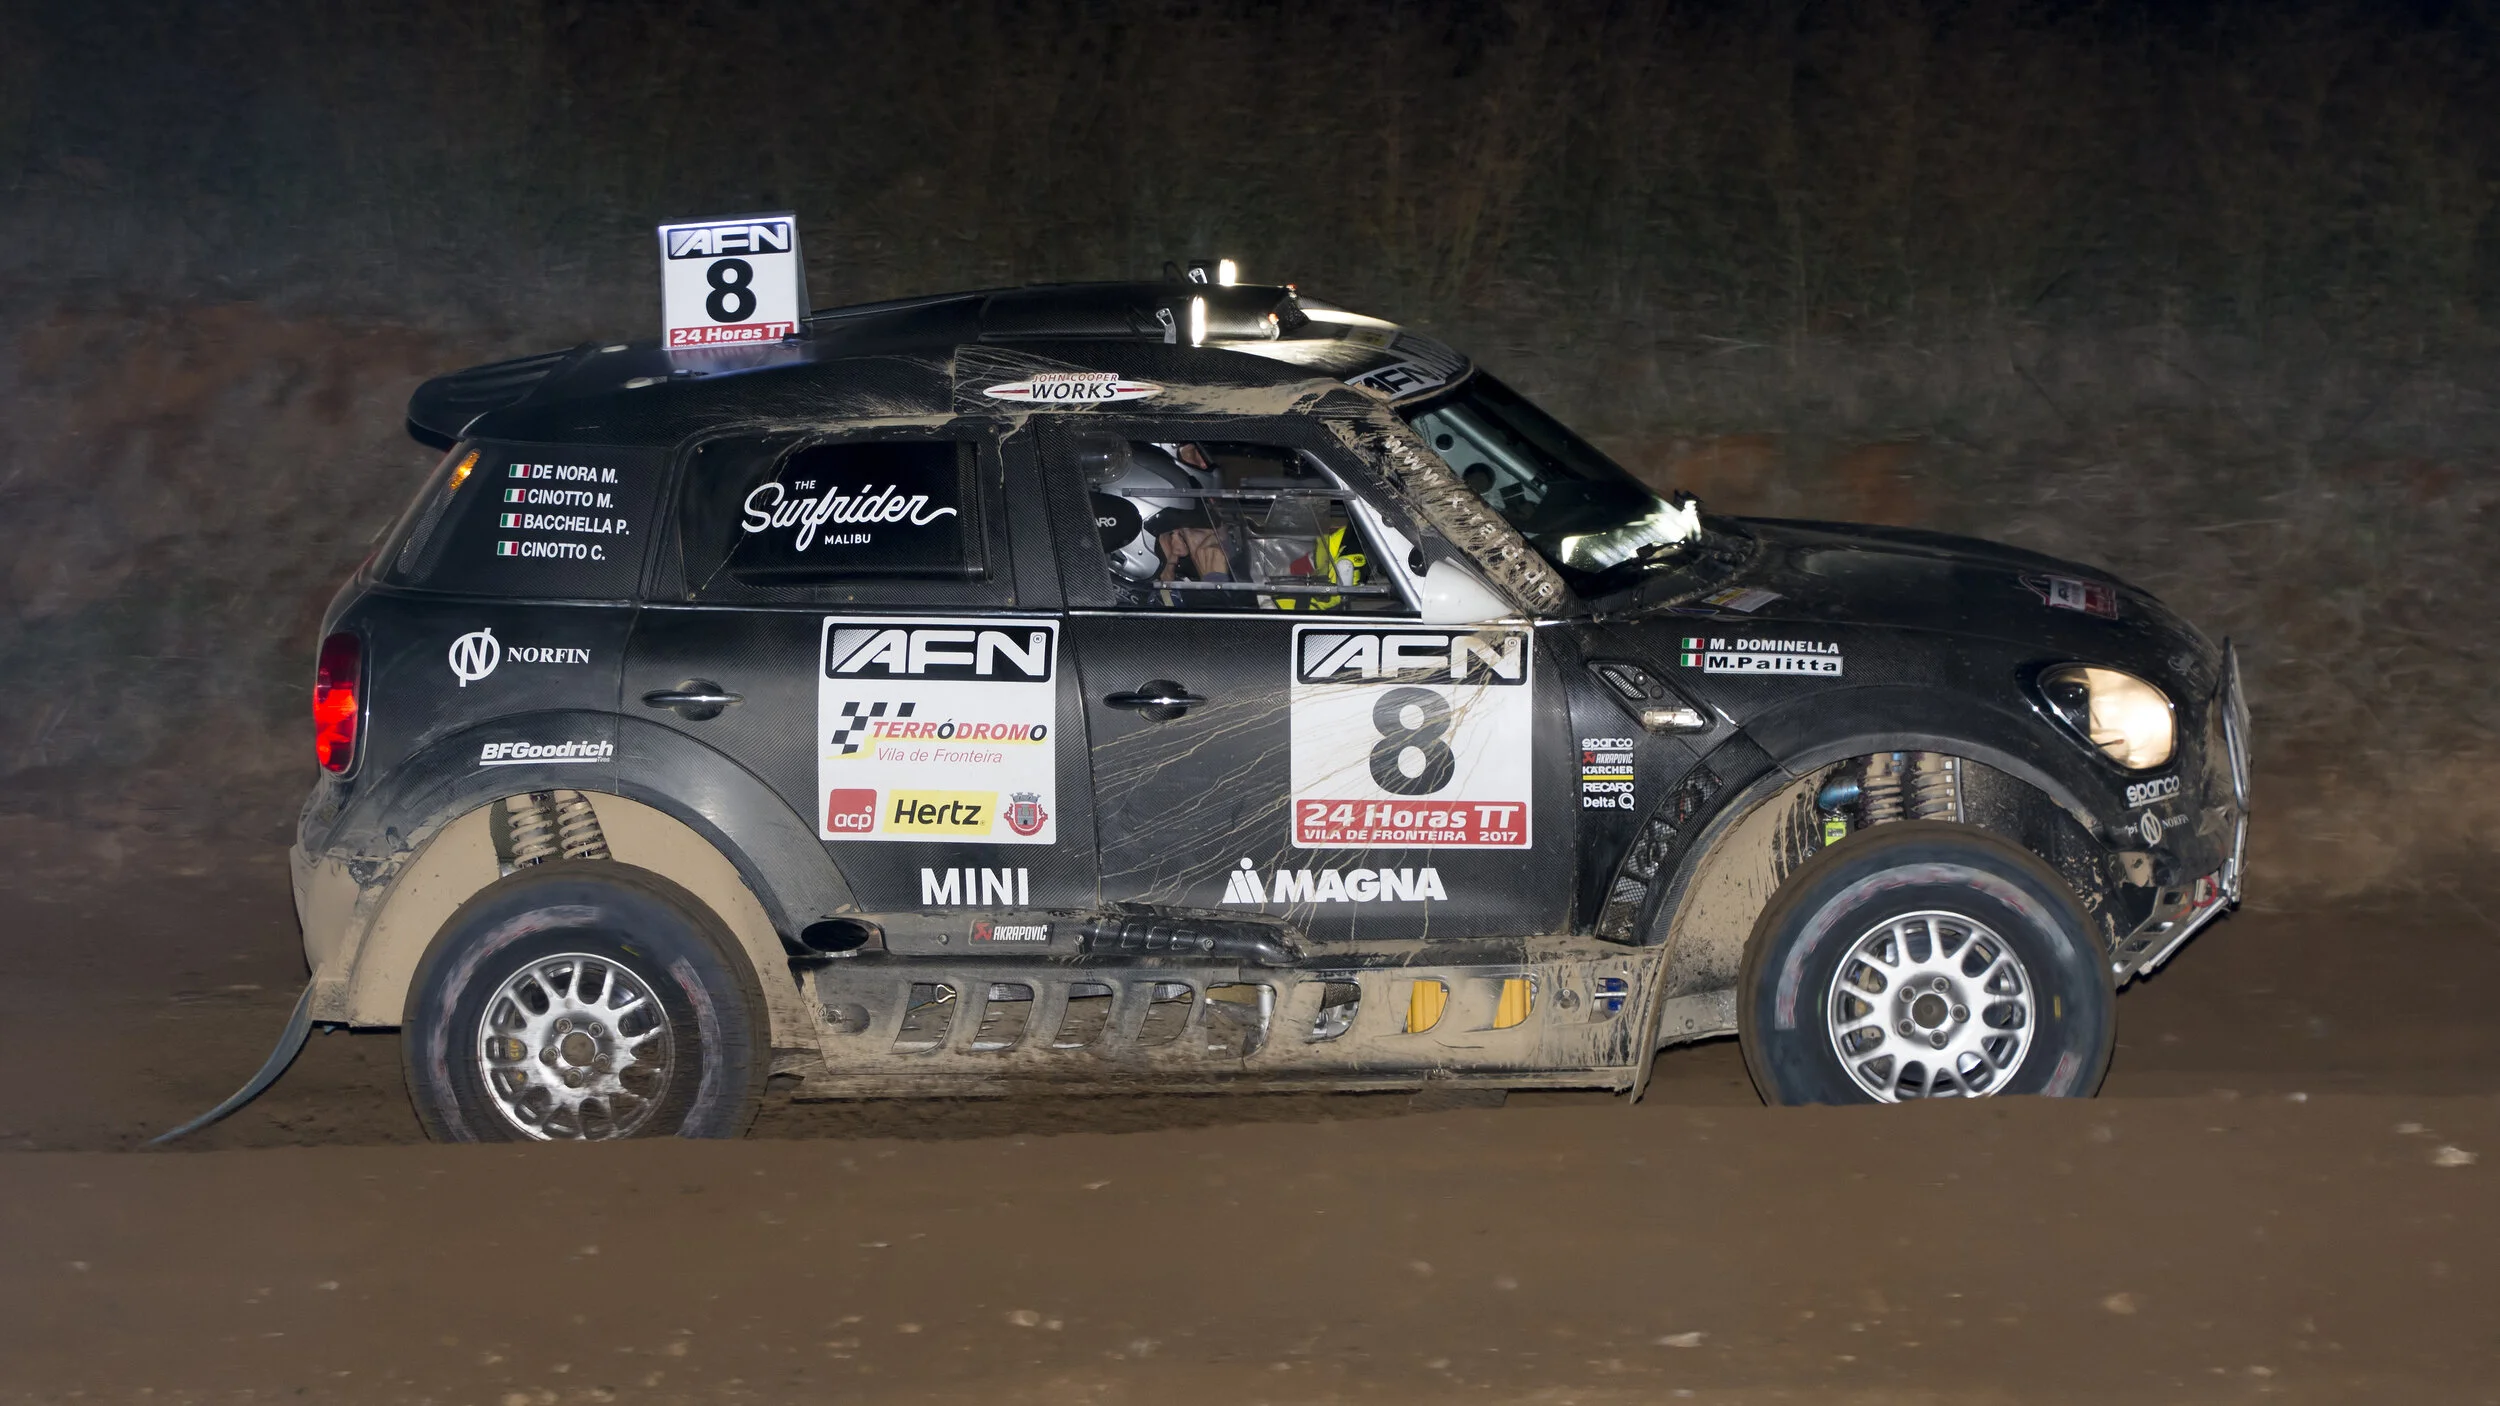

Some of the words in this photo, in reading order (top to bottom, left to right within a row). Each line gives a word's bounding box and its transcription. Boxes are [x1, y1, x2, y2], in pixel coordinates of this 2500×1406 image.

[673, 223, 789, 257] AFN
[706, 258, 757, 323] 8
[673, 329, 702, 344] 24
[705, 327, 762, 341] Horas
[765, 323, 790, 337] TT
[1070, 373, 1118, 382] COOPER
[1032, 383, 1117, 399] WORKS
[532, 464, 553, 479] DE
[556, 465, 597, 482] NORA
[601, 468, 618, 484] M.
[795, 480, 816, 490] THE
[527, 488, 594, 507] CINOTTO
[597, 493, 614, 508] M.
[523, 513, 613, 534] BACCHELLA
[616, 519, 630, 535] P.
[741, 482, 957, 552] Surfrider
[824, 534, 871, 545] MALIBU
[521, 541, 587, 559] CINOTTO
[590, 545, 606, 561] C.
[507, 647, 591, 664] NORFIN
[836, 628, 1047, 677] AFN
[1736, 638, 1840, 654] DOMINELLA
[1307, 634, 1521, 680] AFN
[873, 718, 1048, 741] TERRÓDROMO
[481, 740, 614, 760] BFGoodrich
[1369, 686, 1456, 796] 8
[1581, 737, 1634, 751] sparco
[877, 747, 904, 762] Vila
[909, 748, 928, 762] de
[933, 748, 1003, 764] Fronteira
[1582, 782, 1634, 792] RECARO
[2126, 775, 2180, 807] sparco
[1583, 796, 1616, 808] Delta
[834, 812, 872, 831] acp
[894, 799, 982, 826] Hertz
[1303, 803, 1356, 828] 24
[1364, 803, 1468, 828] Horas
[1474, 805, 1520, 829] TT
[1304, 829, 1342, 841] VILA
[1346, 829, 1368, 841] DE
[1372, 829, 1467, 842] FRONTEIRA
[1480, 831, 1519, 842] 2017
[921, 867, 1029, 906] MINI
[1272, 867, 1448, 904] MAGNA
